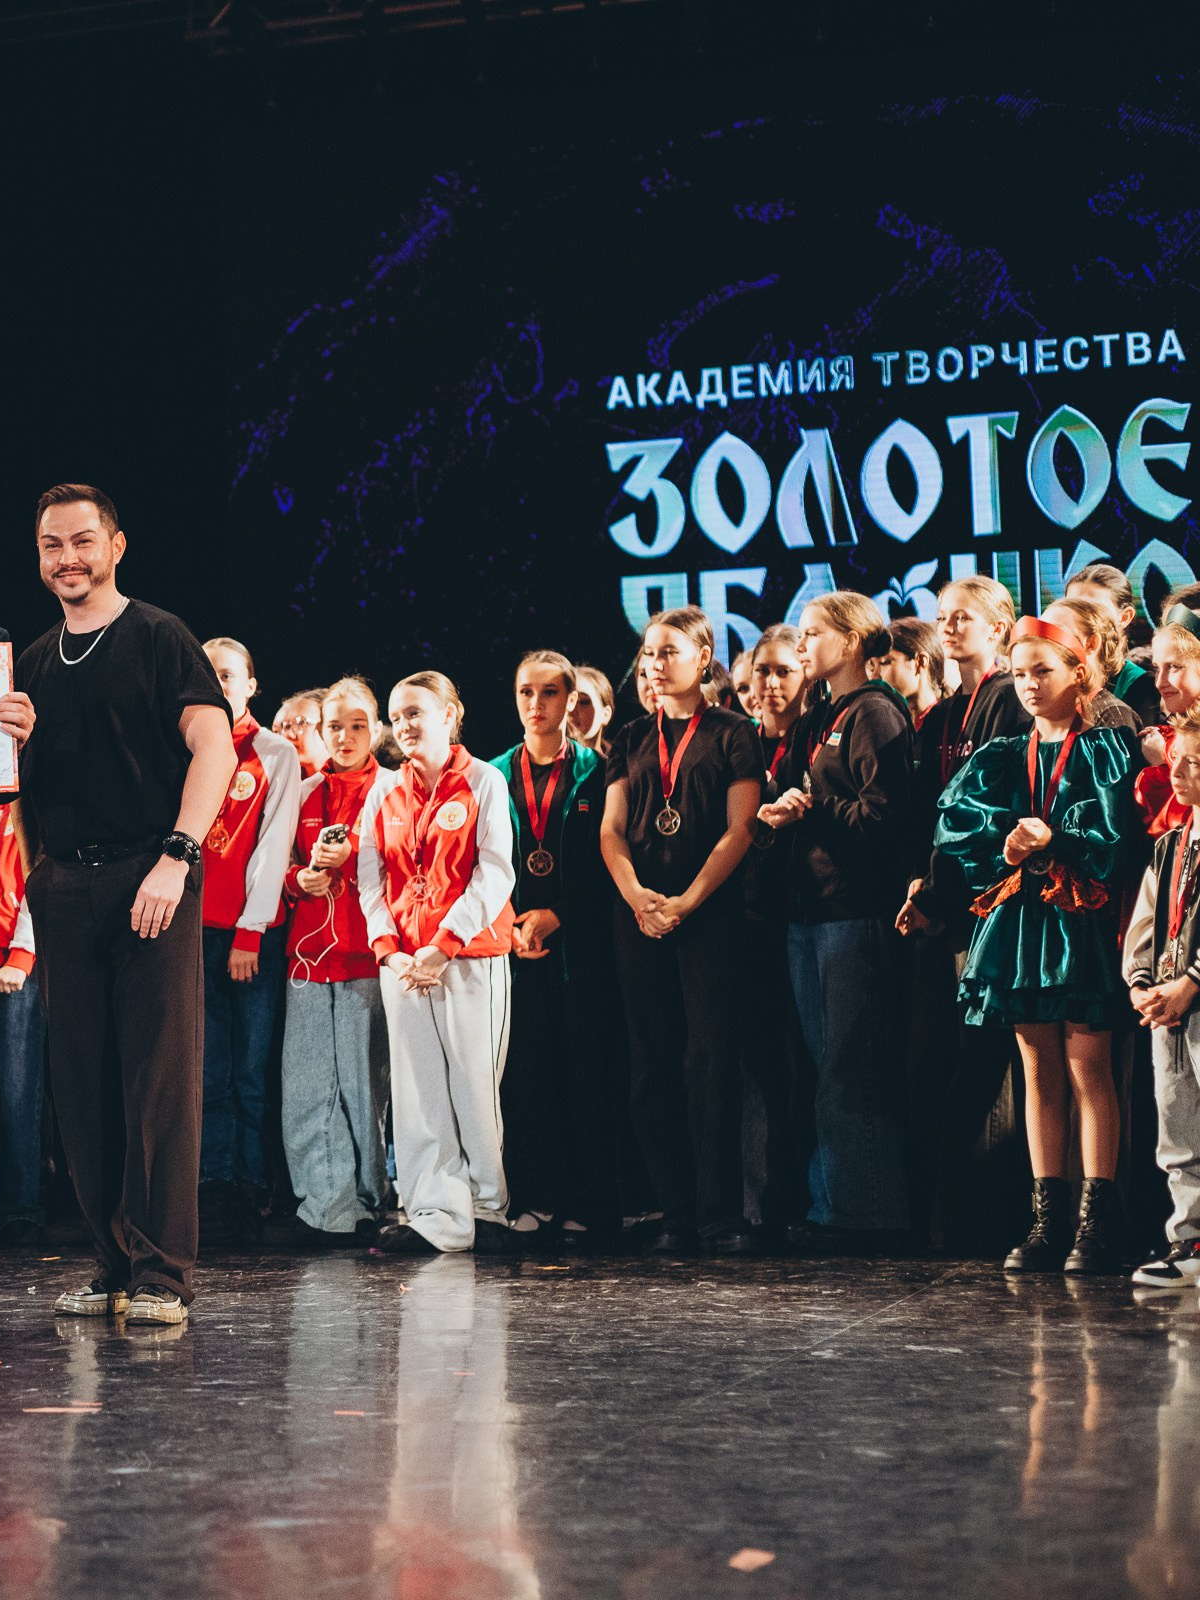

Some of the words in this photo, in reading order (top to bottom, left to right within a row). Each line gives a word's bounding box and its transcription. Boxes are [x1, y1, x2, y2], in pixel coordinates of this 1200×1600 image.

[607, 354, 855, 410] АКАДЕМИЯ
[873, 328, 1186, 388] ТВОРЧЕСТВА
[604, 397, 1193, 559] ЗОЛОТОЕ
